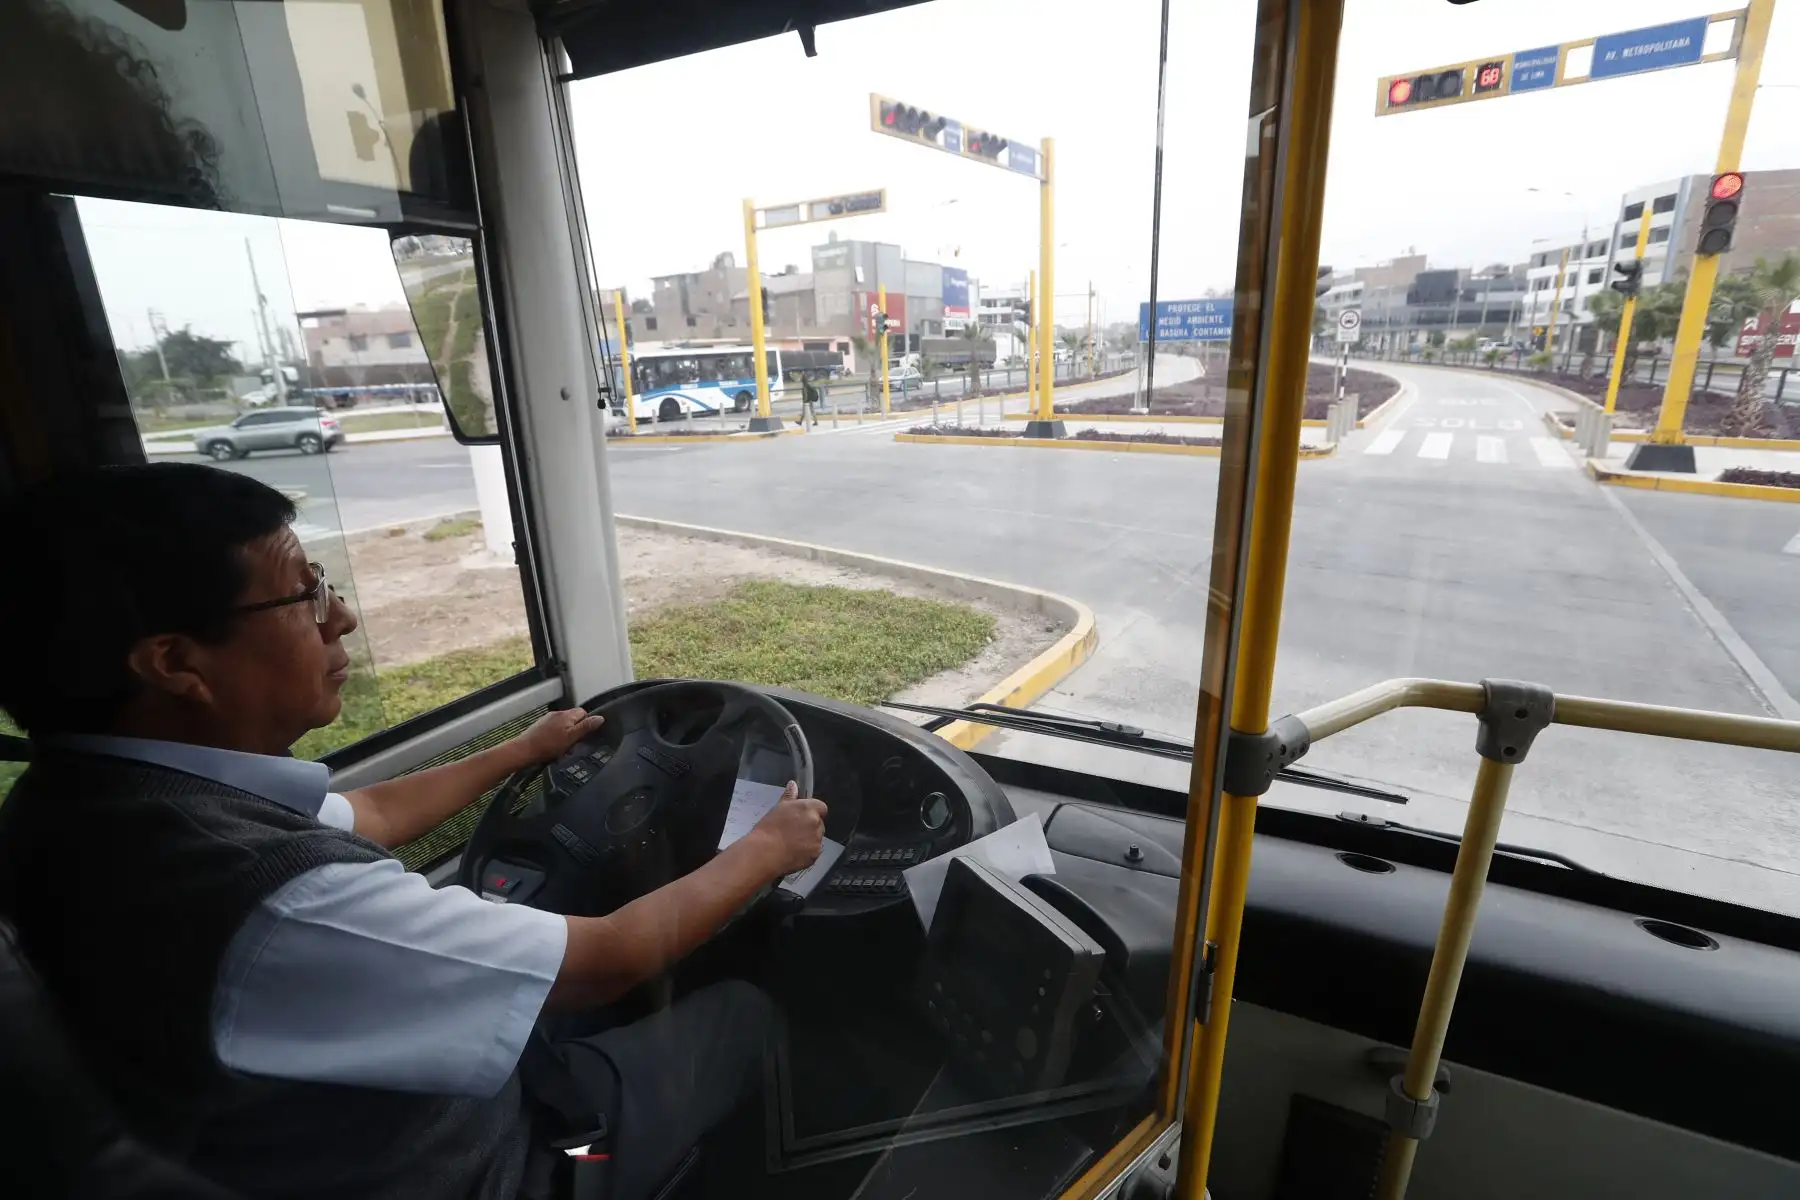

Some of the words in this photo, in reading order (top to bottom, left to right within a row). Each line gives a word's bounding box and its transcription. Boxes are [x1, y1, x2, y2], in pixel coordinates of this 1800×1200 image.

[1623, 36, 1691, 57] METROPOLITANA
[1168, 303, 1201, 312] PROTEGE
[1205, 303, 1215, 311] EL
[1158, 316, 1181, 325] MEDIO
[1187, 315, 1224, 324] AMBIENTE
[1160, 328, 1188, 337] BASURA
[1192, 327, 1232, 336] CONTAMIN
